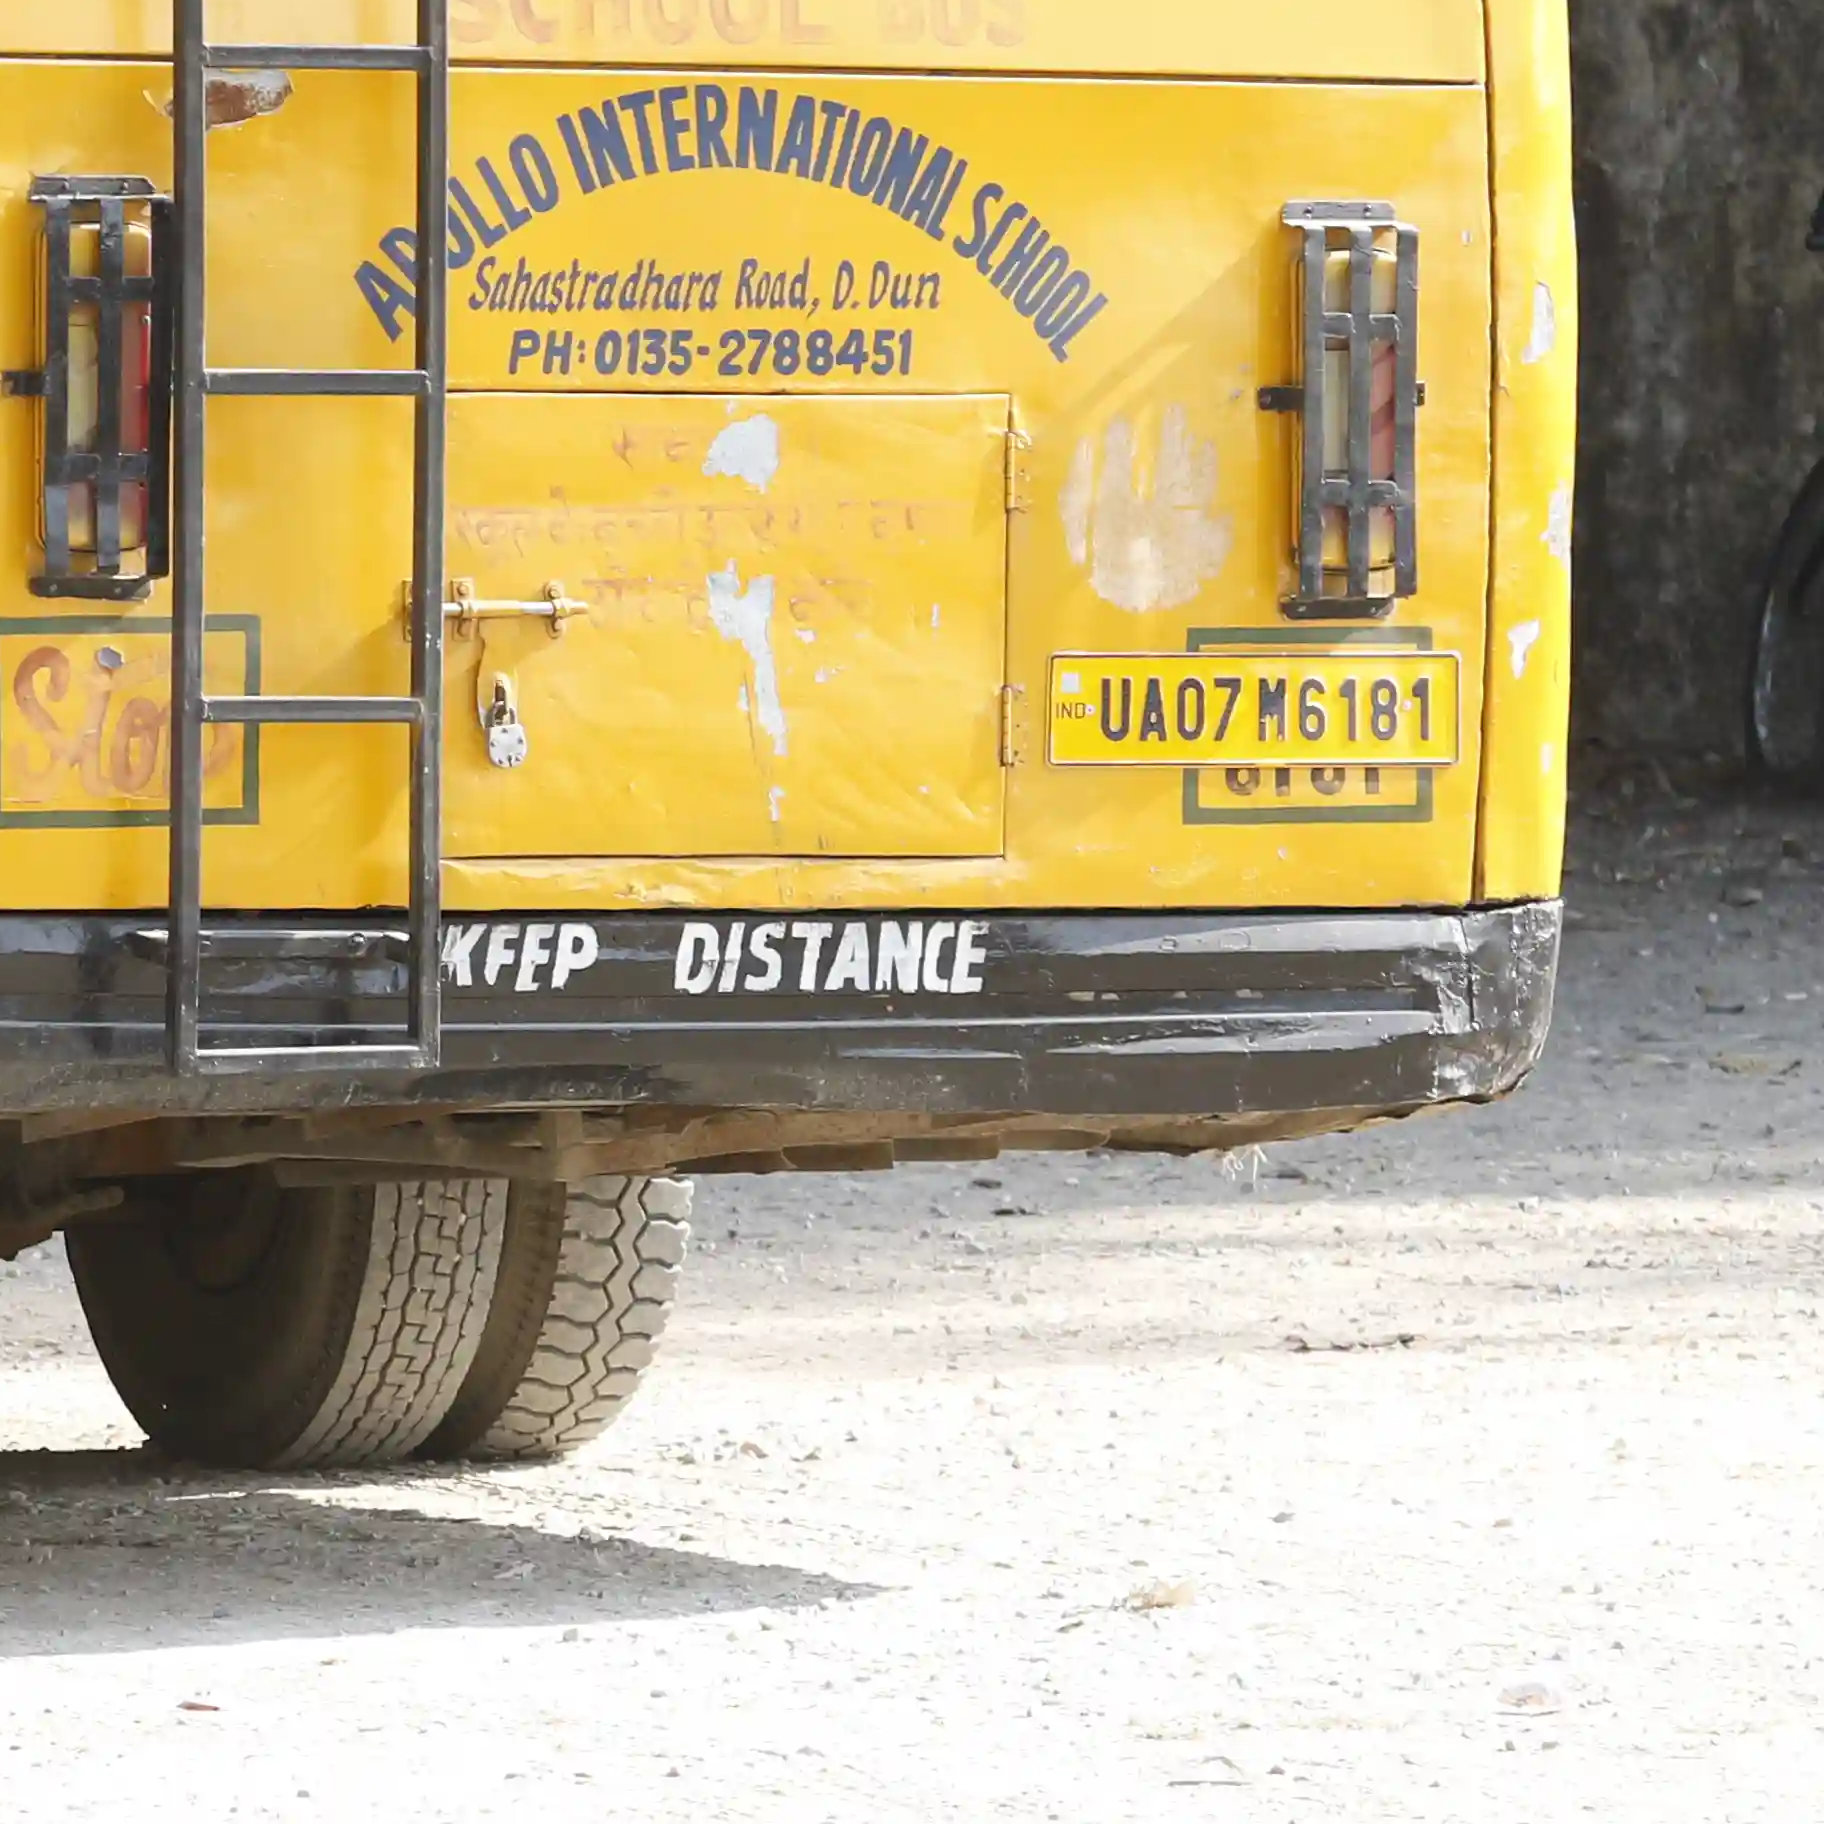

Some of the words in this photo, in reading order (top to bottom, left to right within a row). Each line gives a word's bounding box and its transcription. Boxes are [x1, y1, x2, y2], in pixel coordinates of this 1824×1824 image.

[556, 84, 968, 241] INTERNATIONAL
[952, 183, 1108, 363] SCHOOL
[468, 256, 722, 314] Sahastradhara
[734, 256, 820, 317] Road,
[1056, 702, 1086, 719] IND
[673, 920, 990, 994] DISTANCE
